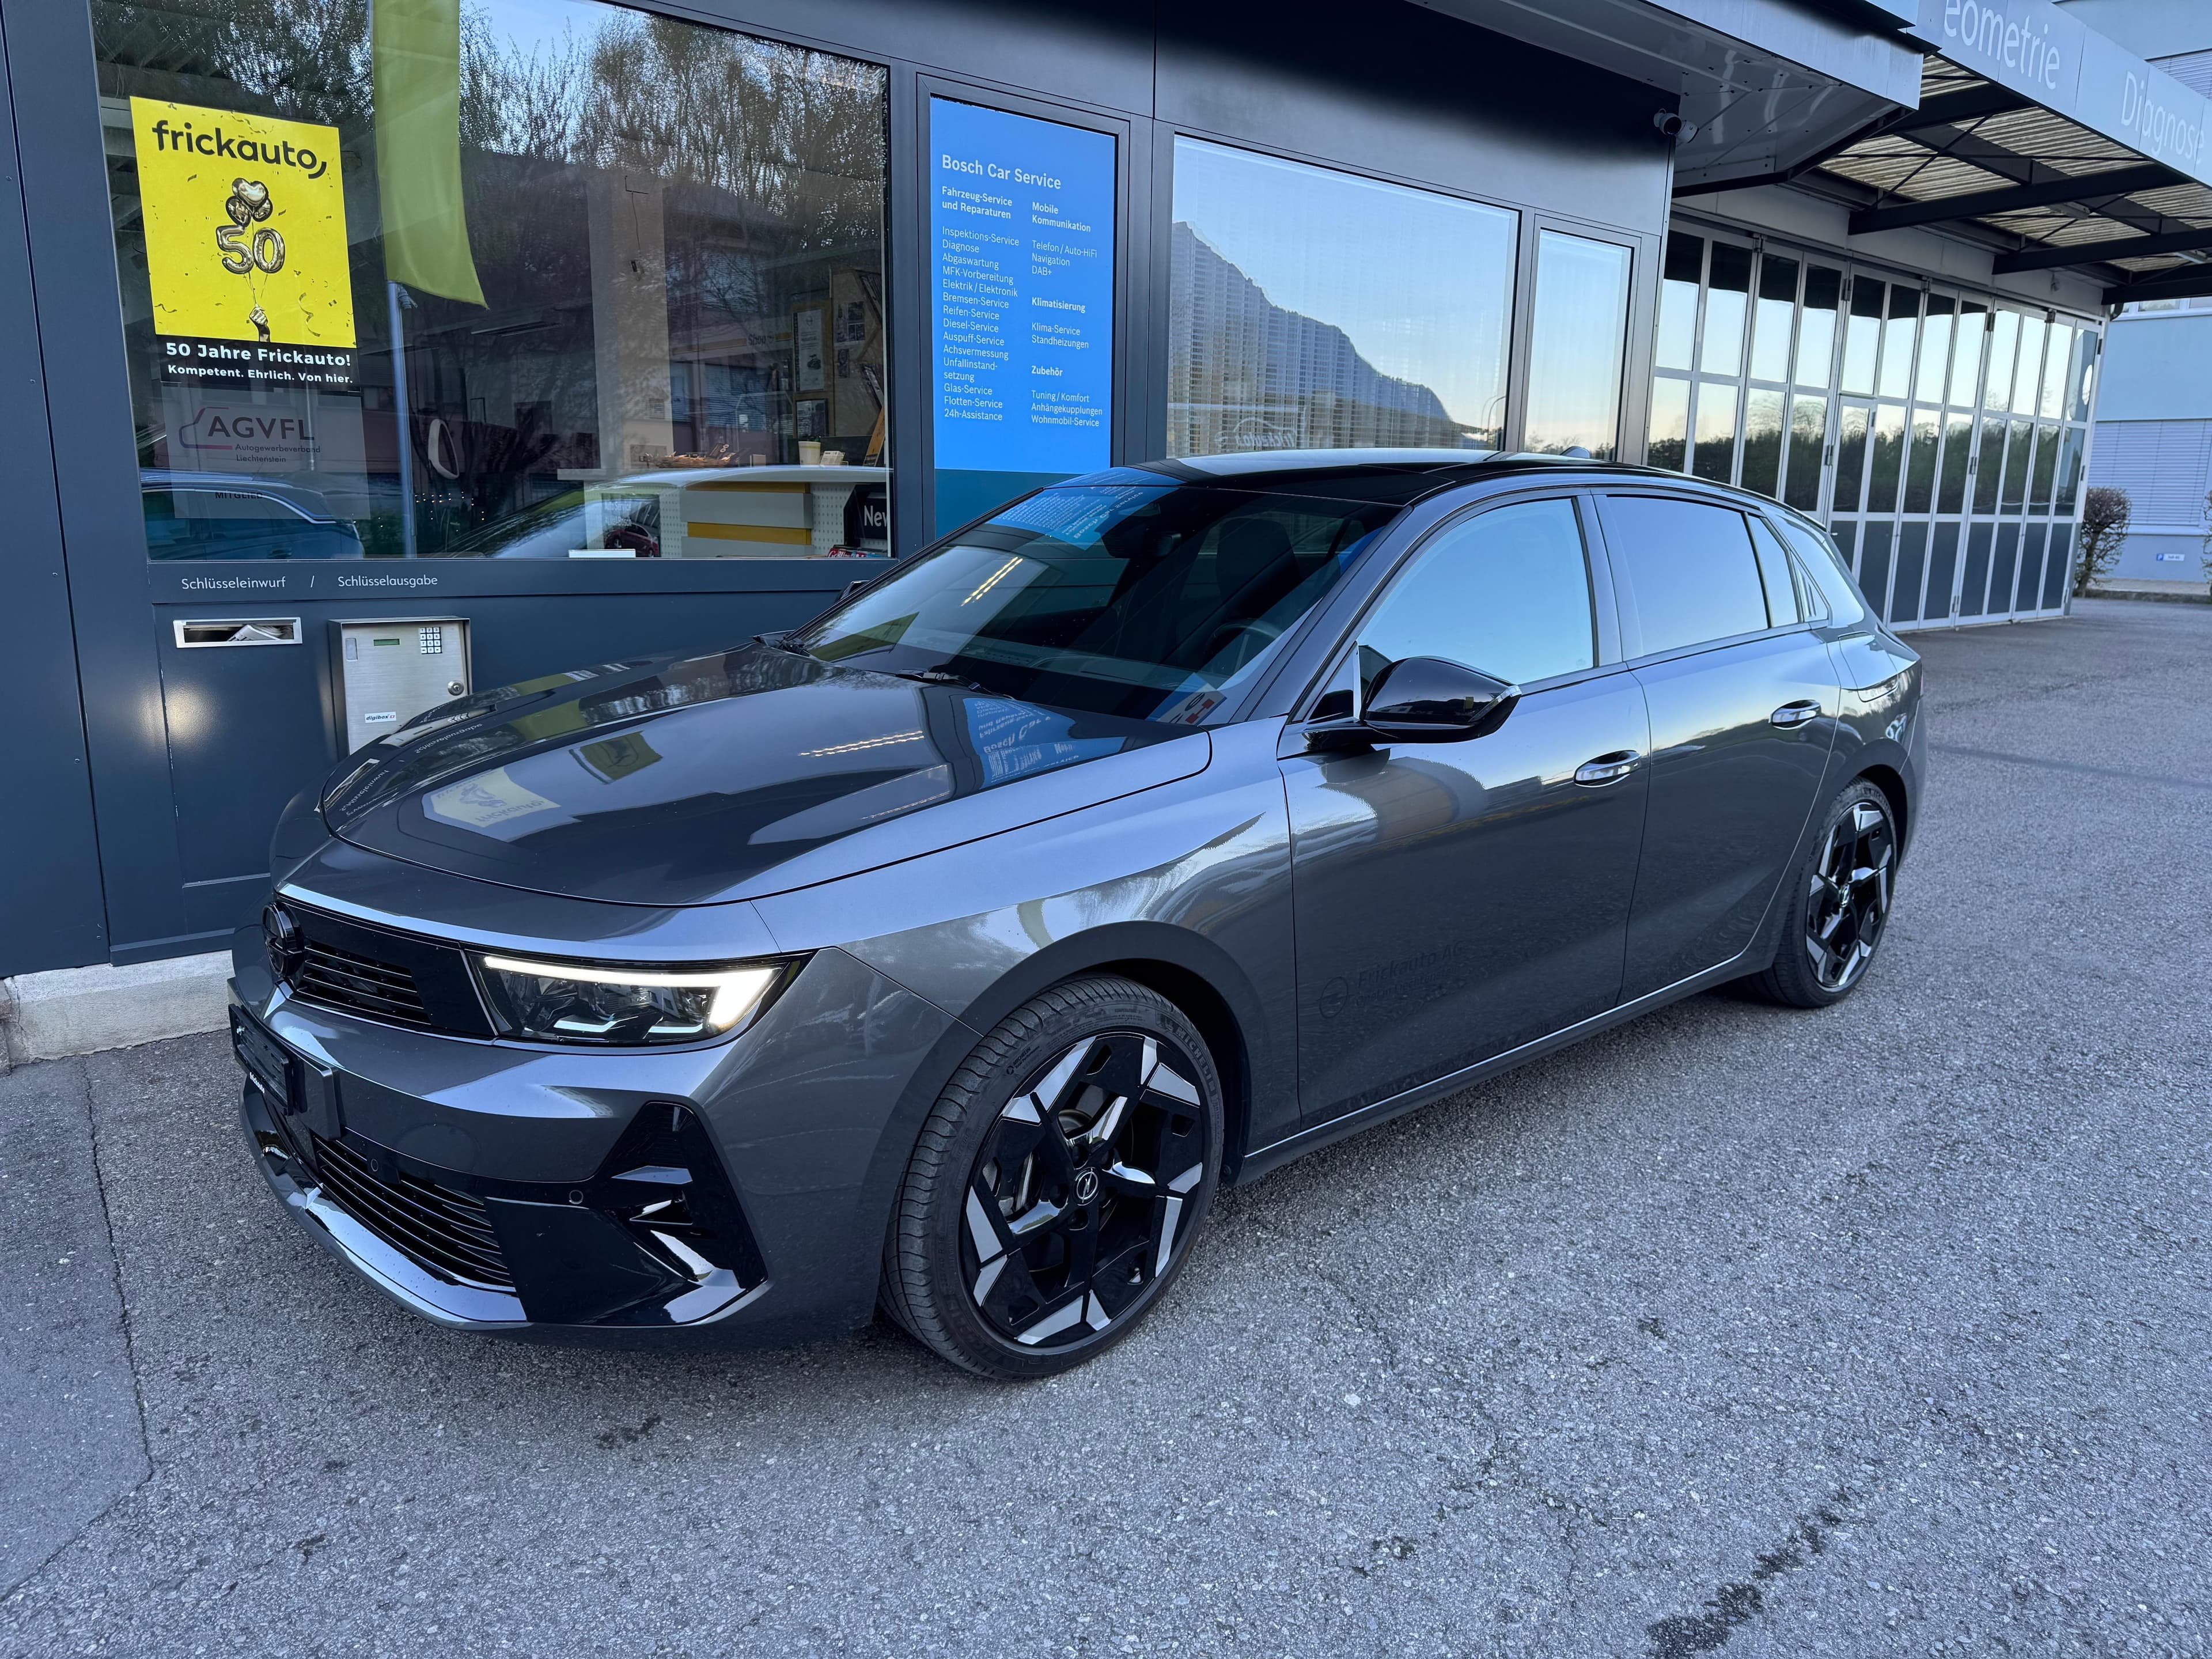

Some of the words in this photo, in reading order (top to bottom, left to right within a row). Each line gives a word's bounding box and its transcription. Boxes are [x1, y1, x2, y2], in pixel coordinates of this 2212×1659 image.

[1944, 0, 2060, 90] eometrie
[2121, 71, 2205, 165] Diagnose
[152, 120, 323, 173] frickauto
[942, 154, 983, 175] Bosch
[987, 163, 1010, 180] Car
[1014, 168, 1061, 190] Service
[942, 185, 1012, 206] Fahrzeug-Service
[942, 200, 957, 210] und
[960, 202, 1011, 219] Reparaturen
[1032, 202, 1058, 214] Mobile
[1032, 214, 1090, 232] Kommunikation
[942, 226, 1019, 246] Inspektions-Service
[215, 225, 285, 275] 50
[942, 239, 979, 253] Diagnose
[1032, 240, 1059, 252] Telefon
[1060, 244, 1063, 253] /
[1065, 245, 1097, 258] Auto-HiFi
[942, 252, 999, 270] Abgaswartung
[1032, 253, 1070, 266] Navigation
[942, 265, 1014, 285] MFK-Vorbereitung
[1032, 265, 1052, 276] DAB+
[943, 279, 973, 291] Elektrik
[974, 282, 978, 293] /
[979, 283, 1018, 297] Elektronik
[943, 292, 1009, 309] Bremsen-Service
[1032, 297, 1086, 313] Klimatisierung
[943, 305, 999, 320] Reifen-Service
[943, 318, 998, 333] Diesel-Service
[1032, 322, 1080, 336] Klima-Service
[943, 331, 1005, 346] Auspuff-Service
[1032, 334, 1089, 350] Standheizungen
[166, 343, 191, 356] 50
[198, 344, 251, 360] Jahre
[257, 349, 351, 366] Frickauto!
[944, 344, 1009, 361] Achsvermessung
[944, 357, 997, 370] Unfallinstand-
[1032, 365, 1063, 377] Zubehör
[168, 365, 244, 377] Kompetent.
[248, 369, 295, 381] Ehrlich.
[298, 373, 321, 382] Von
[326, 374, 353, 384] hier.
[944, 372, 975, 382] setzung
[944, 382, 992, 395] Glas-Service
[1032, 390, 1056, 402] Tuning
[1056, 391, 1060, 402] /
[1061, 392, 1089, 403] Komfort
[944, 396, 1003, 408] Flotten-Service
[1031, 403, 1103, 416] Anhängekupplungen
[944, 408, 1002, 421] 24h-Assistance
[1031, 414, 1099, 427] Wohnmobil-Service
[207, 416, 315, 440] AGVFL
[235, 444, 320, 453] Autogewerbeverband
[181, 577, 286, 589] Schlüsseleinwurf
[310, 575, 315, 588] /
[338, 575, 438, 588] Schlüsselausgabe
